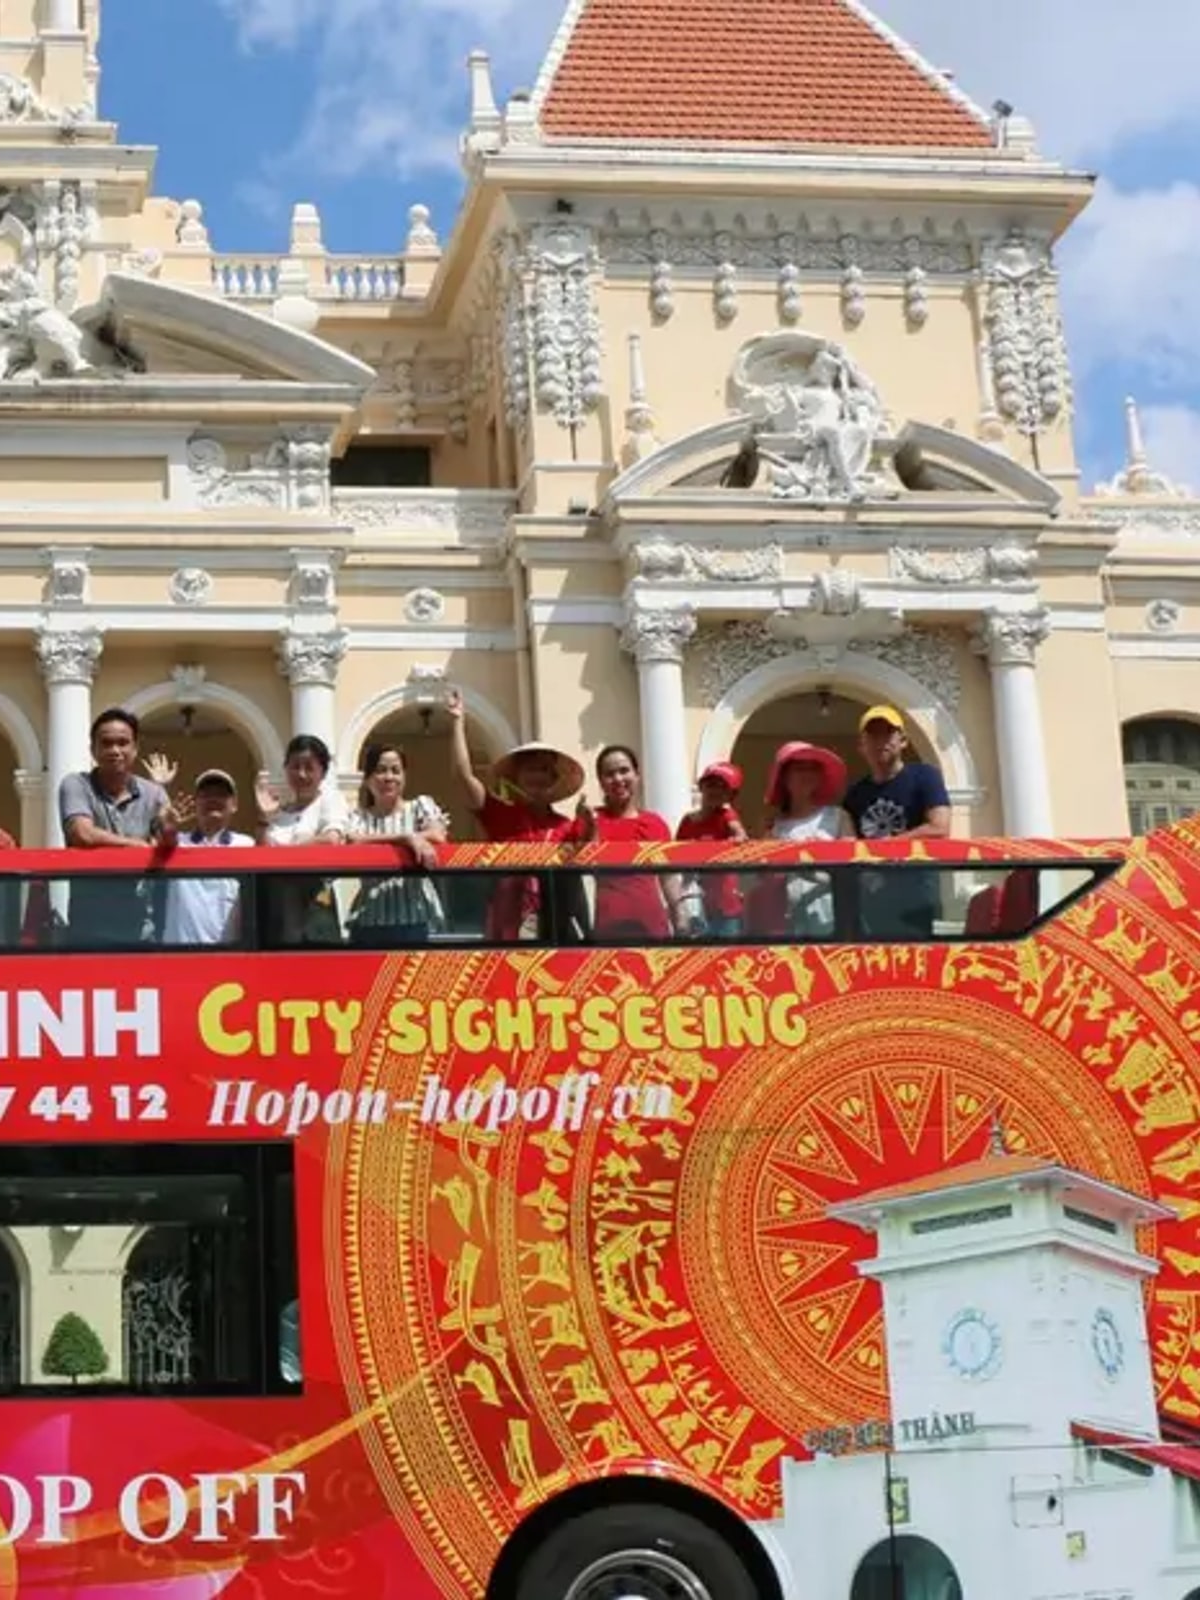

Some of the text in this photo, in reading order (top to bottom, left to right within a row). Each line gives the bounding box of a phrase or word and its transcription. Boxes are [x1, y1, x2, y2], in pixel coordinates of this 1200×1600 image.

[198, 982, 362, 1056] CITY
[387, 992, 808, 1055] SIGHTSEEING
[29, 1086, 92, 1121] 44
[110, 1085, 167, 1120] 12
[208, 1071, 674, 1135] Hopon-hopoff.vn
[118, 1472, 305, 1544] OFF
